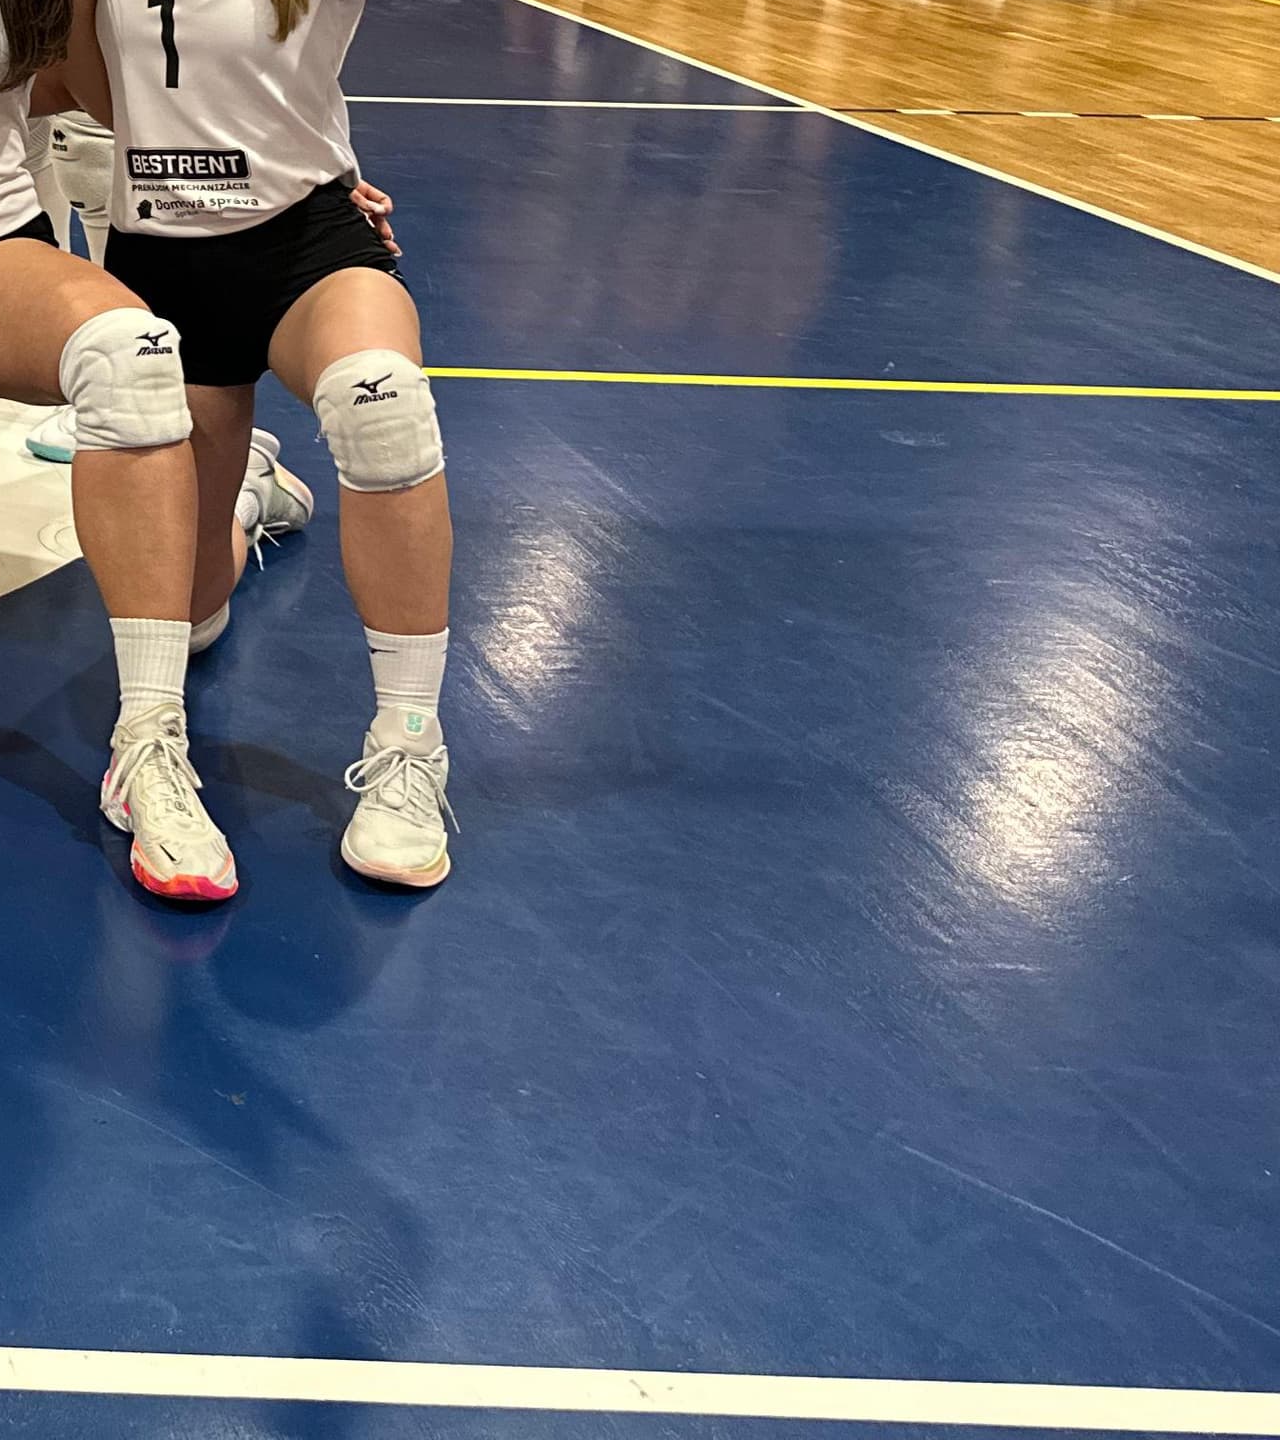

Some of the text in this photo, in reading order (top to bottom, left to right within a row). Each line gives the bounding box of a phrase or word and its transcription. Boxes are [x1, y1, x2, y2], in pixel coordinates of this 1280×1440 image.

[132, 154, 240, 174] BESTRENT
[171, 181, 251, 192] MECHANIZÁCIE
[154, 196, 205, 211] Domová
